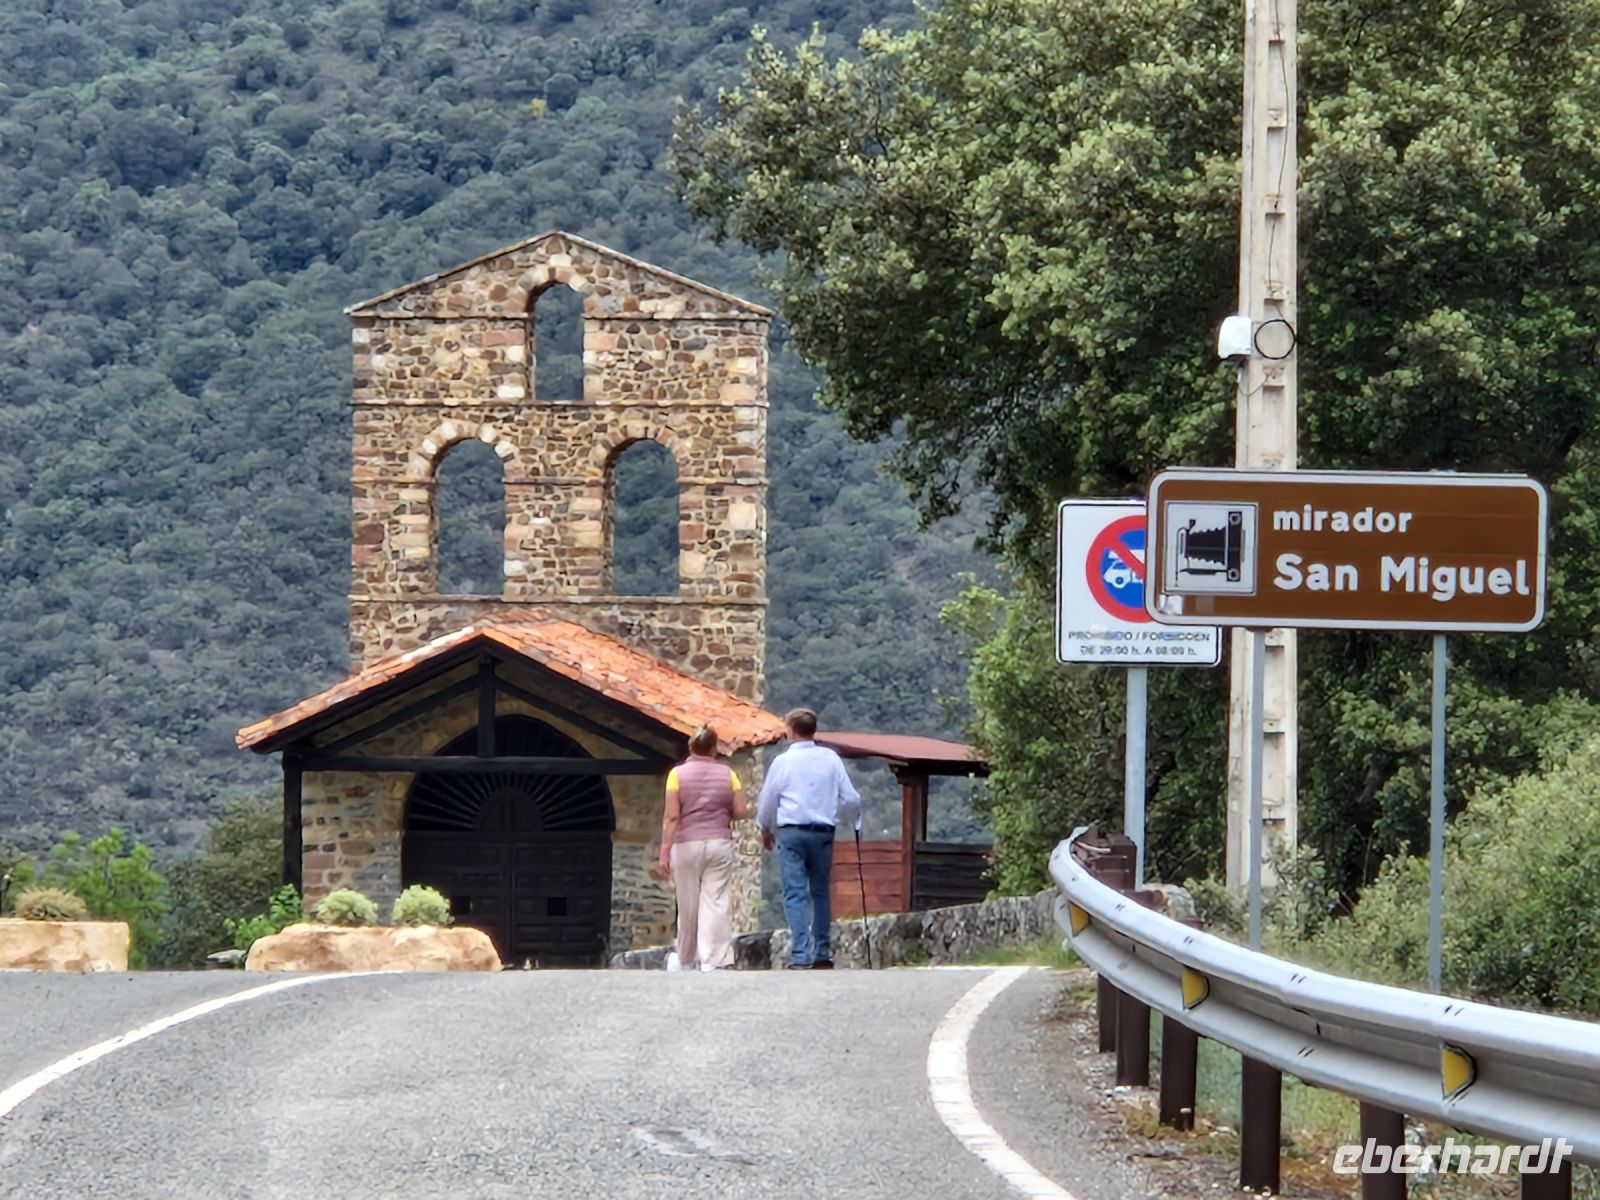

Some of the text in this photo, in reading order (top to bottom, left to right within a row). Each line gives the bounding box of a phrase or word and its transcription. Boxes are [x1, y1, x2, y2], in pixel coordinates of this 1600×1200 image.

[1272, 504, 1413, 533] mirador
[1273, 553, 1531, 602] San Miguel
[1068, 631, 1133, 641] PRODO
[1144, 646, 1153, 655] A
